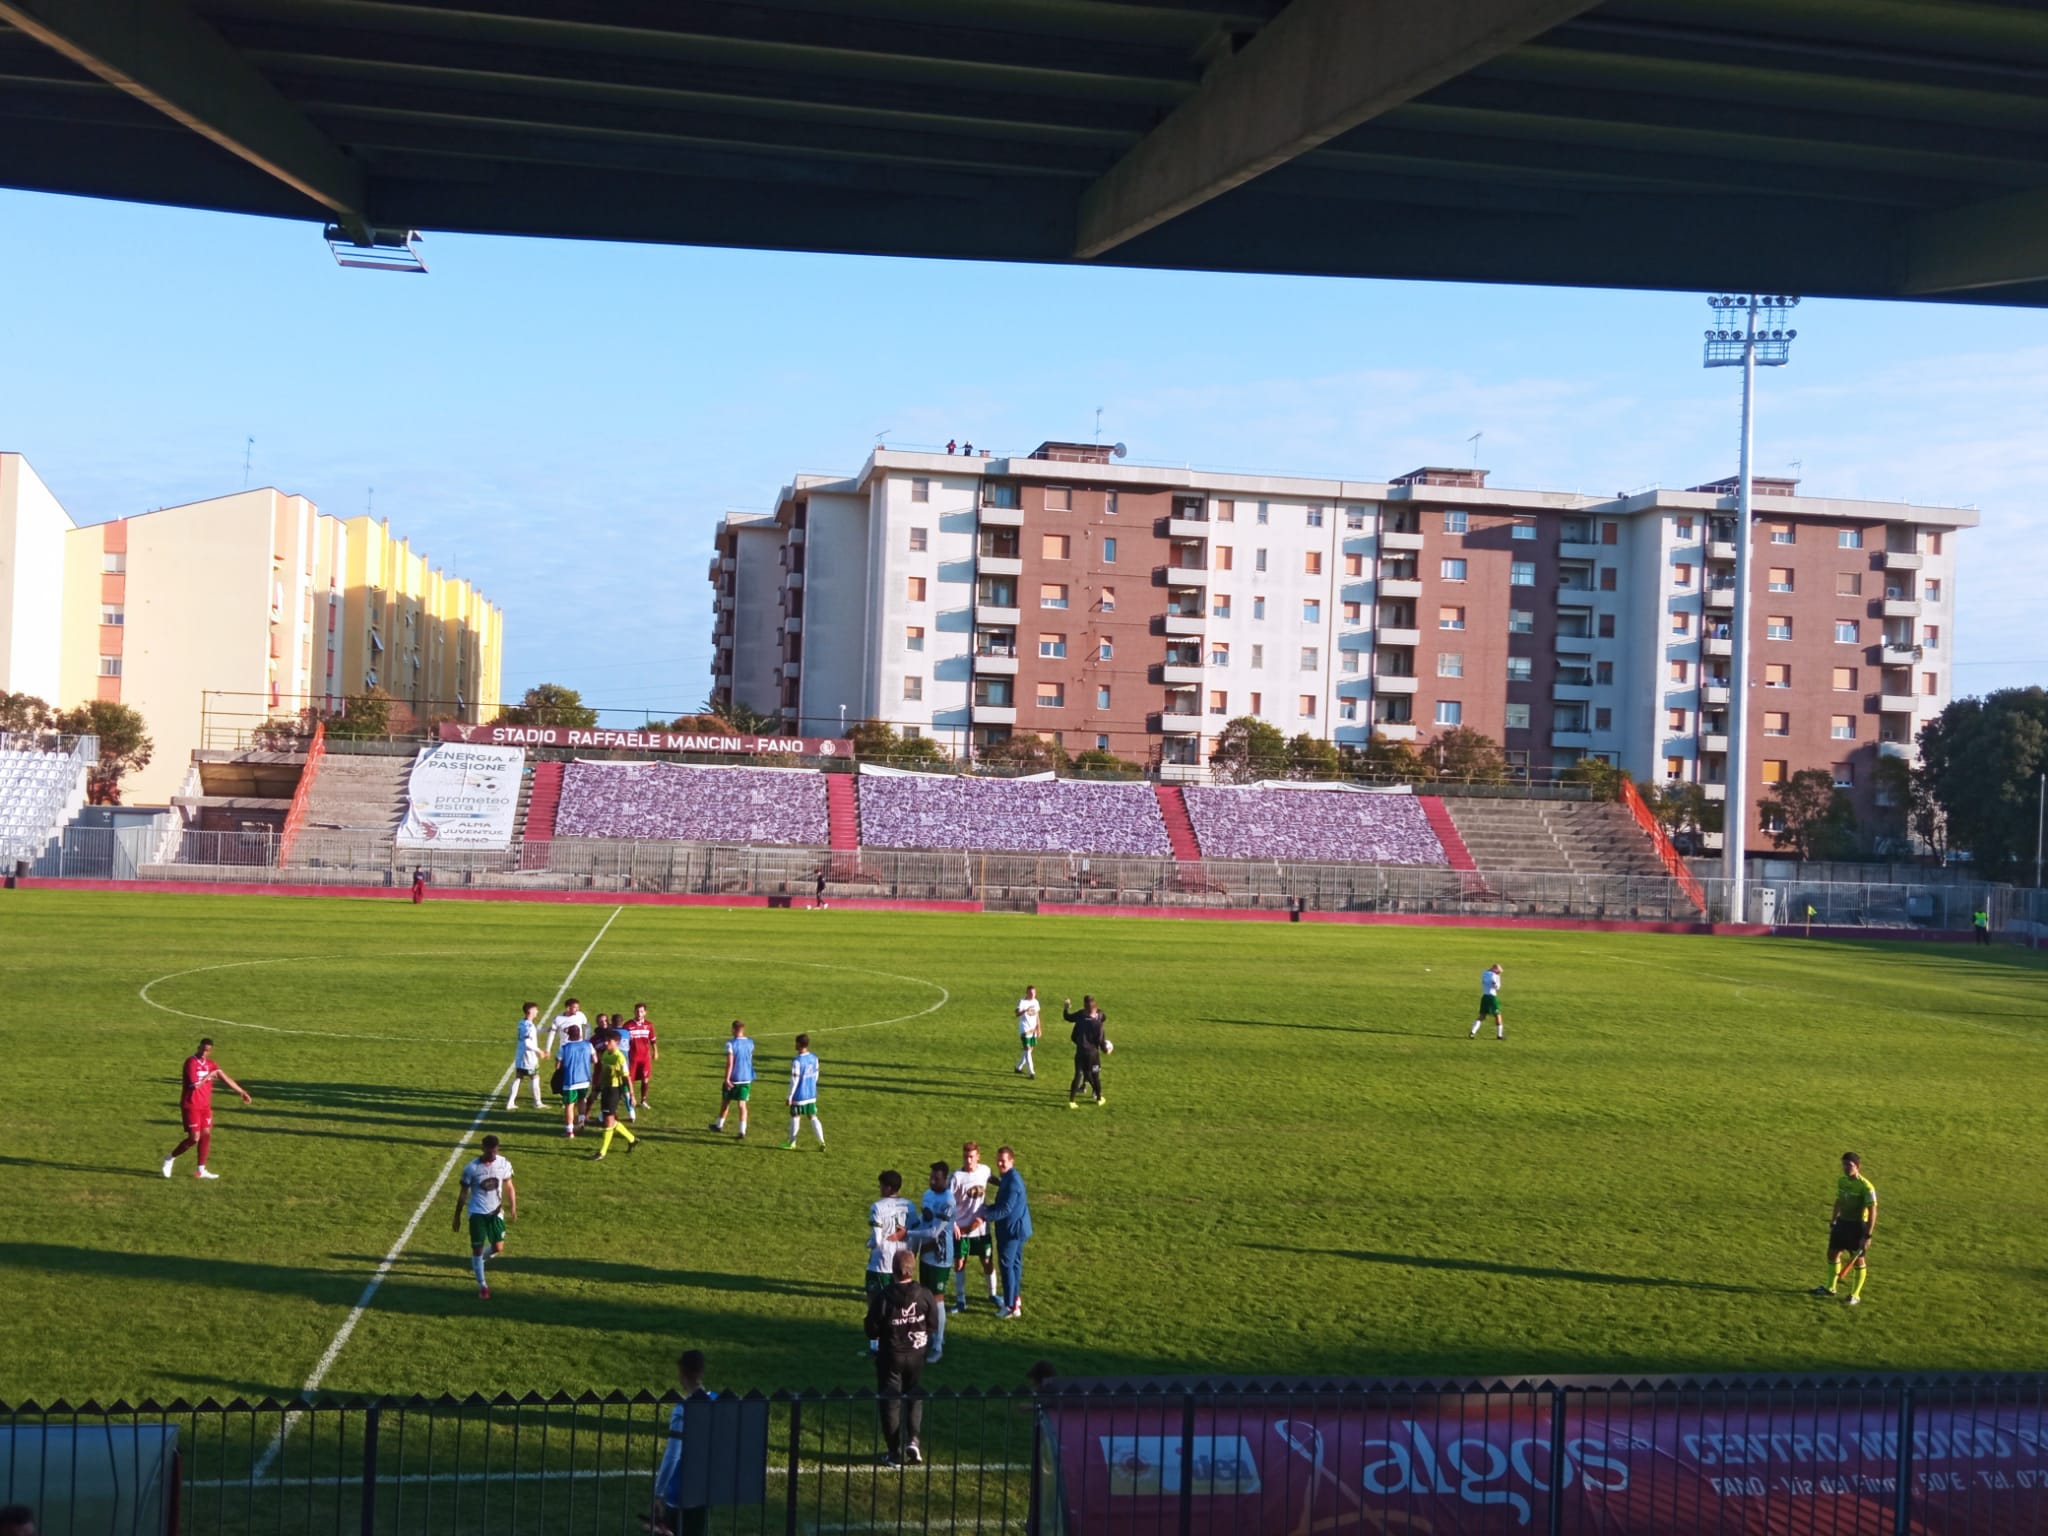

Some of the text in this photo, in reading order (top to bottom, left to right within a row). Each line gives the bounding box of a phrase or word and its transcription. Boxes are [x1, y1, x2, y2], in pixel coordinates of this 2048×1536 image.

[492, 728, 557, 744] STADIO
[568, 732, 661, 748] RAFFAELE
[667, 735, 741, 751] MANCINI
[757, 738, 804, 753] FANO
[433, 751, 503, 762] ENERGIA
[428, 760, 507, 771] PASSIONE
[434, 796, 510, 805] prometeo
[434, 803, 474, 811] estra
[1683, 1432, 1849, 1465] CENTRO
[1361, 1419, 1630, 1527] algos
[1711, 1475, 1767, 1497] FANO
